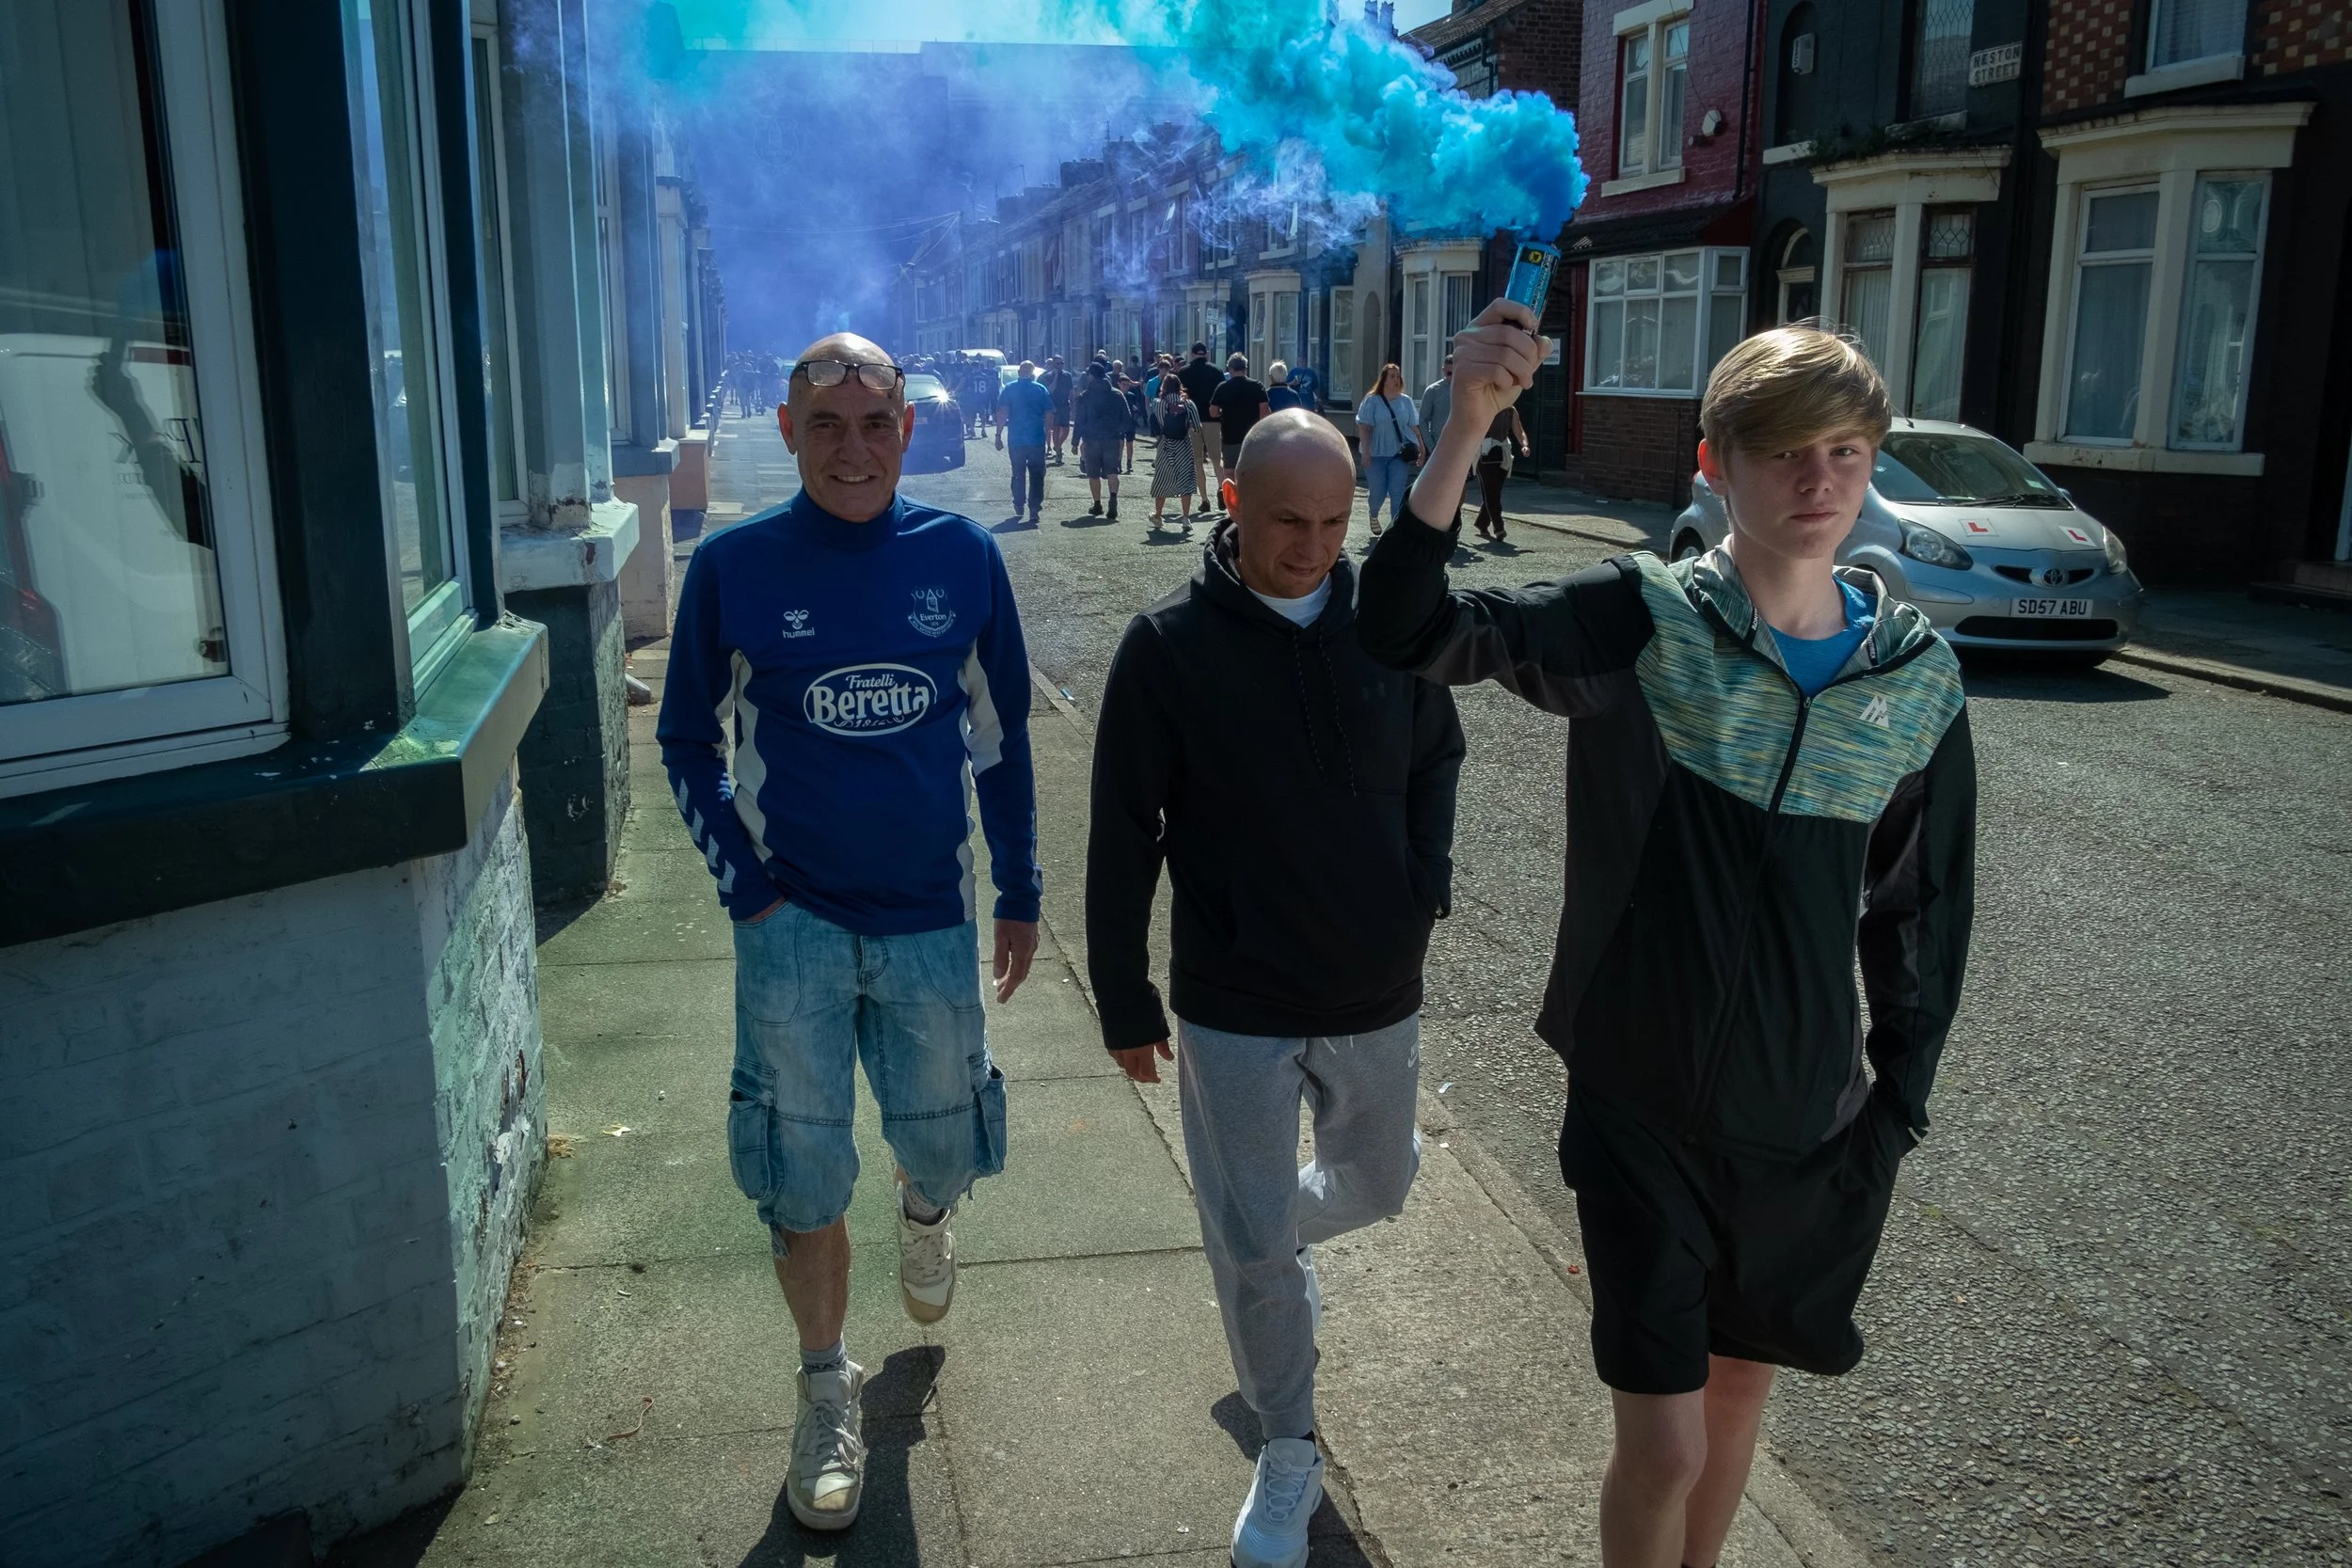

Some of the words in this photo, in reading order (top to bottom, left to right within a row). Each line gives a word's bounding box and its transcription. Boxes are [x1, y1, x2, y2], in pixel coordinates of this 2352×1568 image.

[1973, 45, 2021, 69] NESTON
[1974, 61, 2018, 83] STREET
[973, 380, 987, 393] 18
[1967, 522, 1989, 532] L
[2018, 599, 2057, 615] SD57
[2059, 599, 2088, 615] ABU
[919, 613, 946, 622] Everton
[783, 627, 815, 639] hummel
[846, 673, 896, 689] Fratelli
[810, 682, 930, 723] Beretta
